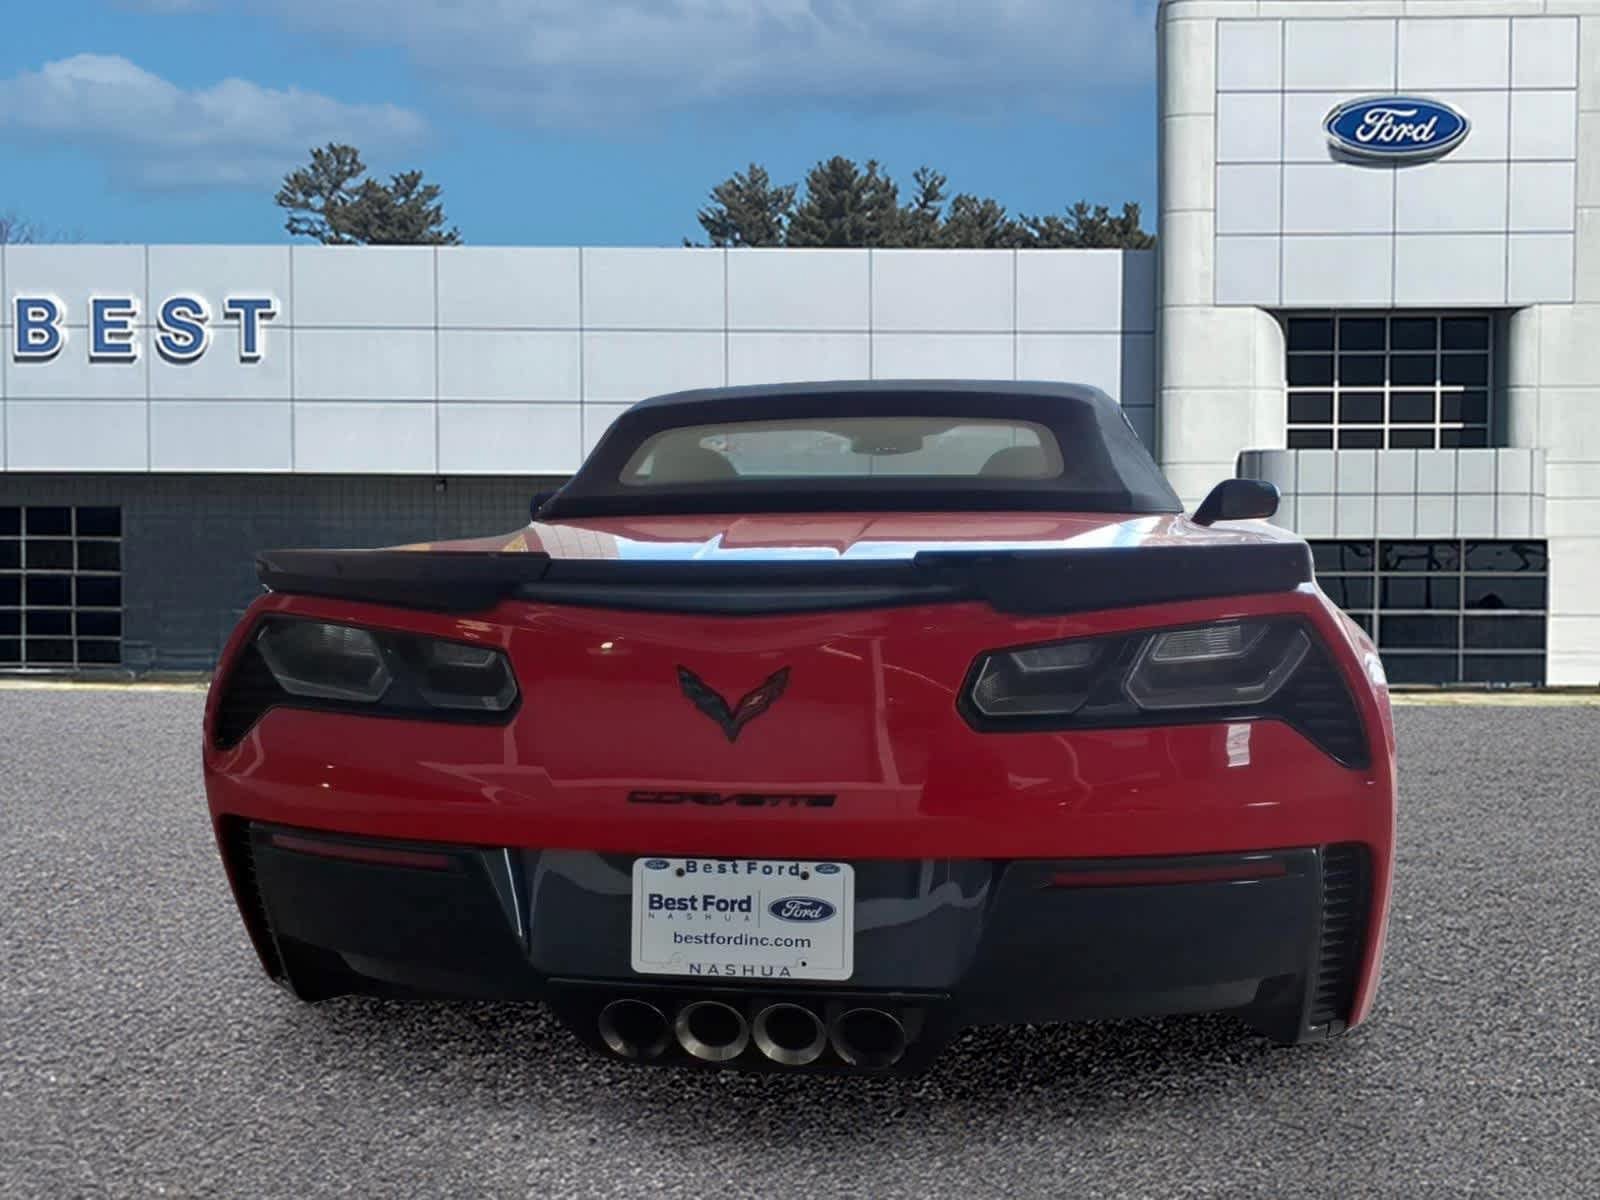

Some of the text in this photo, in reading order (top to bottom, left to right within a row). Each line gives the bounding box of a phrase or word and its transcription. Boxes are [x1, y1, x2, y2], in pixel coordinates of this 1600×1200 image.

[1355, 107, 1439, 142] Ford
[13, 296, 275, 361] BEST
[685, 861, 800, 876] Best Ford
[649, 894, 751, 912] Best Ford
[780, 900, 822, 918] Ford
[649, 912, 750, 922] NASHUA
[673, 931, 811, 948] bestfordinc.com
[689, 964, 791, 977] NASHUA
